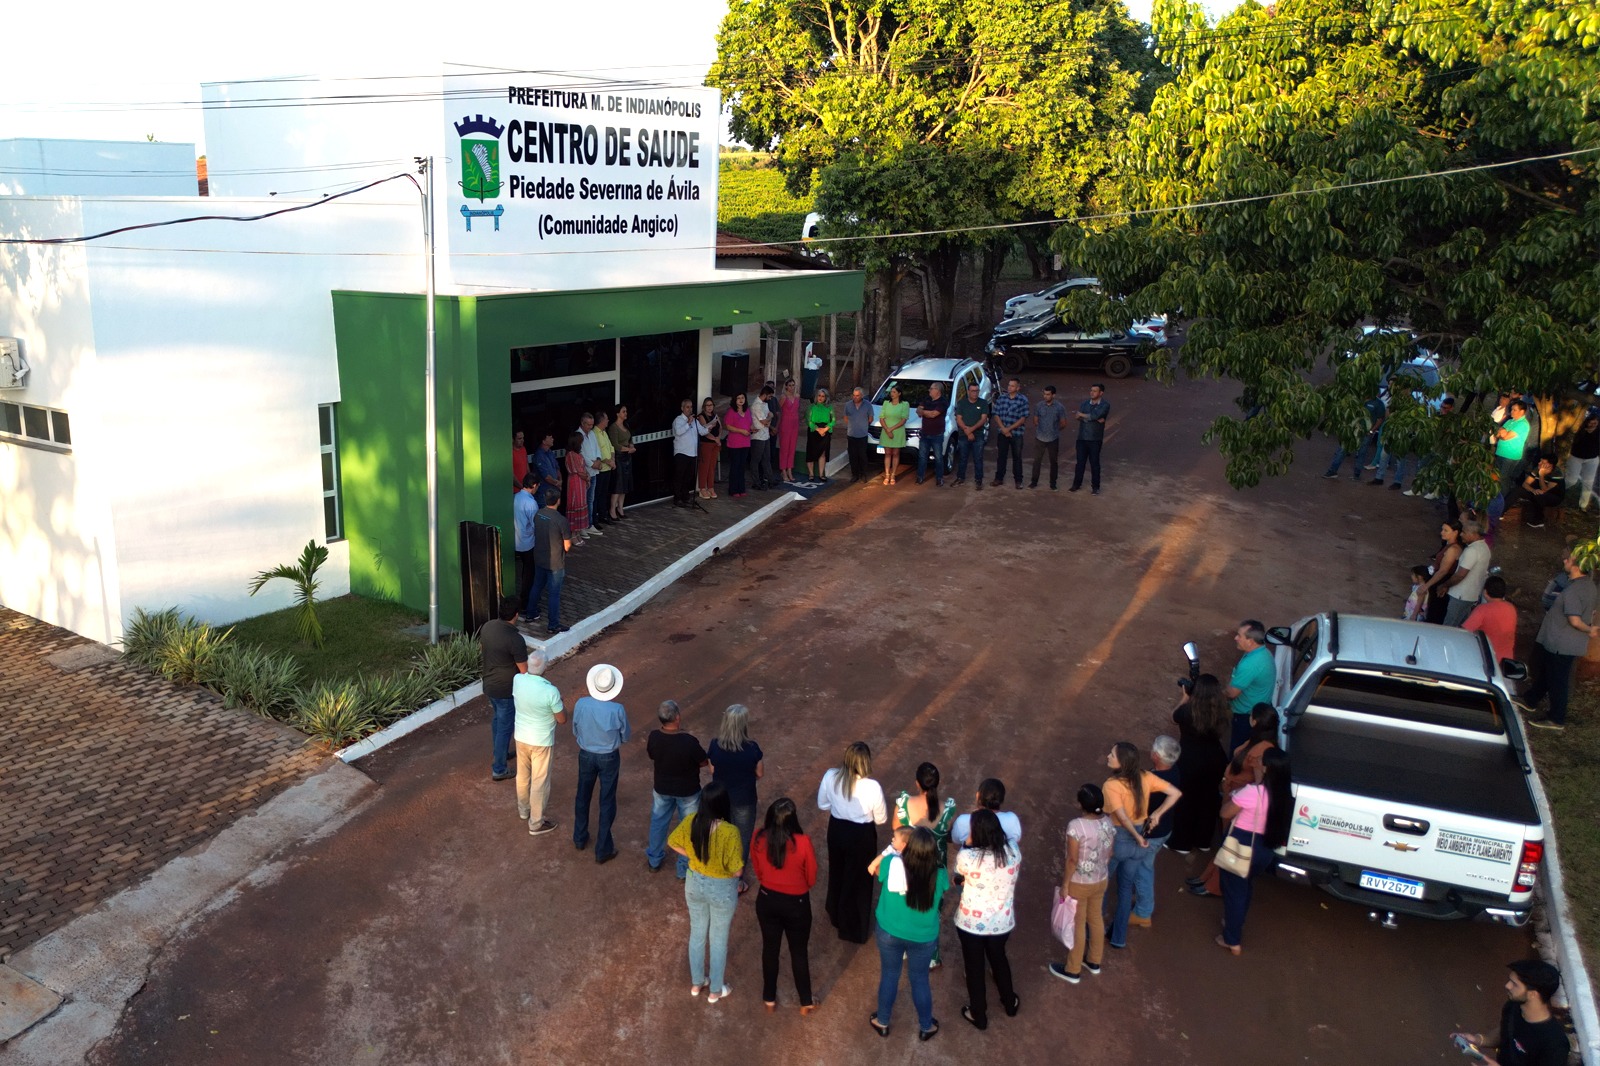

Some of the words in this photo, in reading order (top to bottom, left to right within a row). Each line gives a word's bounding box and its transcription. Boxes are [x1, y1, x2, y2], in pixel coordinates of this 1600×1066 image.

[508, 86, 588, 109] PREFEITURA
[591, 94, 604, 111] M.
[607, 95, 622, 113] DE
[626, 97, 701, 119] INDIANÓPOLIS
[507, 119, 598, 165] CENTRO
[605, 126, 631, 167] DE
[636, 129, 699, 169] SAUDE
[509, 175, 575, 200] Piedade
[579, 177, 642, 200] Severina
[646, 180, 663, 200] de
[667, 175, 700, 201] Ávila
[538, 214, 628, 239] (Comunidade
[631, 214, 678, 238] Angico)
[1319, 817, 1374, 833] INDIANÓPOLIS-MG
[1435, 837, 1449, 849] MEIO
[1448, 840, 1473, 854] AMBIENTE
[1471, 843, 1477, 855] E
[1476, 844, 1513, 862] PLANEJAMENTO
[1438, 832, 1473, 842] SECRETARIA
[1473, 838, 1504, 848] MUNICIPAL
[1366, 876, 1417, 896] RVY2G70
